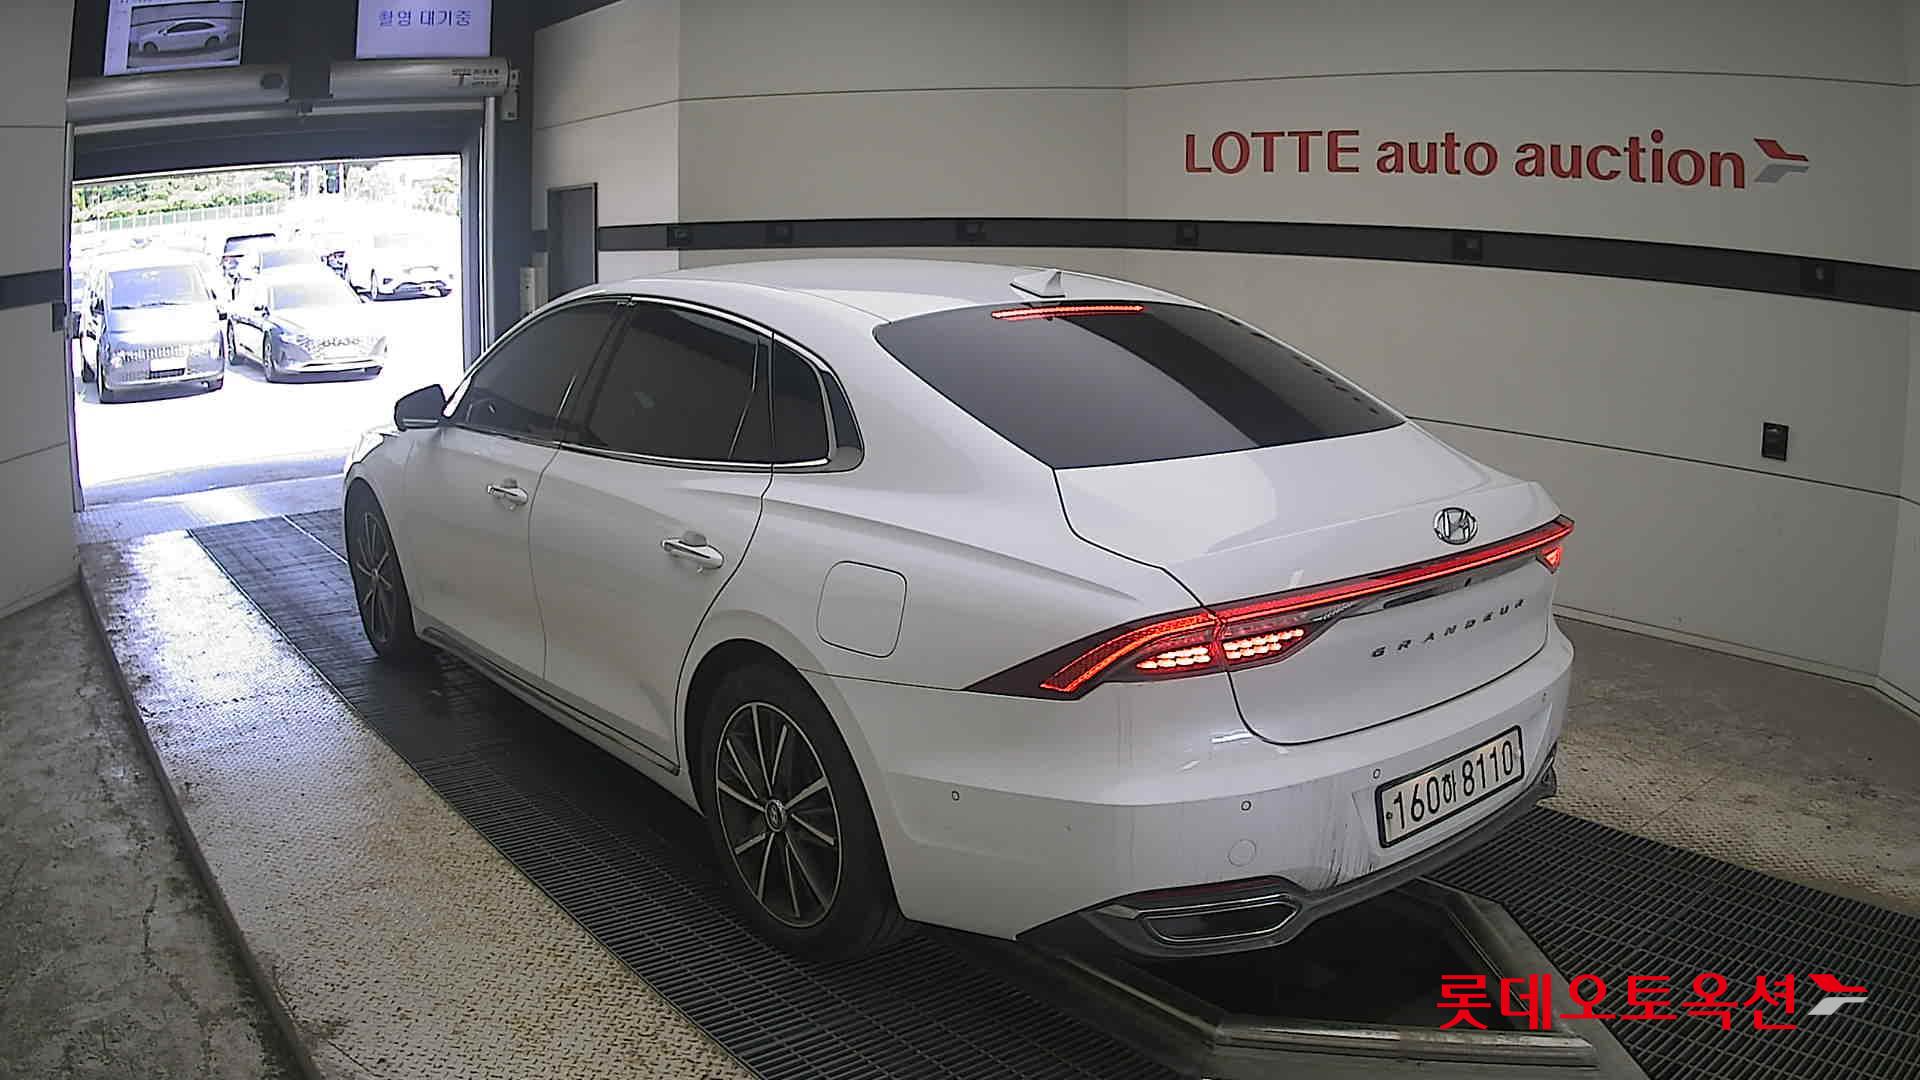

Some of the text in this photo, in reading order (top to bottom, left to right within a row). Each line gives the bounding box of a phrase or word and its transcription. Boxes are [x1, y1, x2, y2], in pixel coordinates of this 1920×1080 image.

[420, 10, 472, 26] 대기중
[1185, 129, 1746, 189] LOTTE auto auction
[1371, 599, 1525, 658] GRANDEUR
